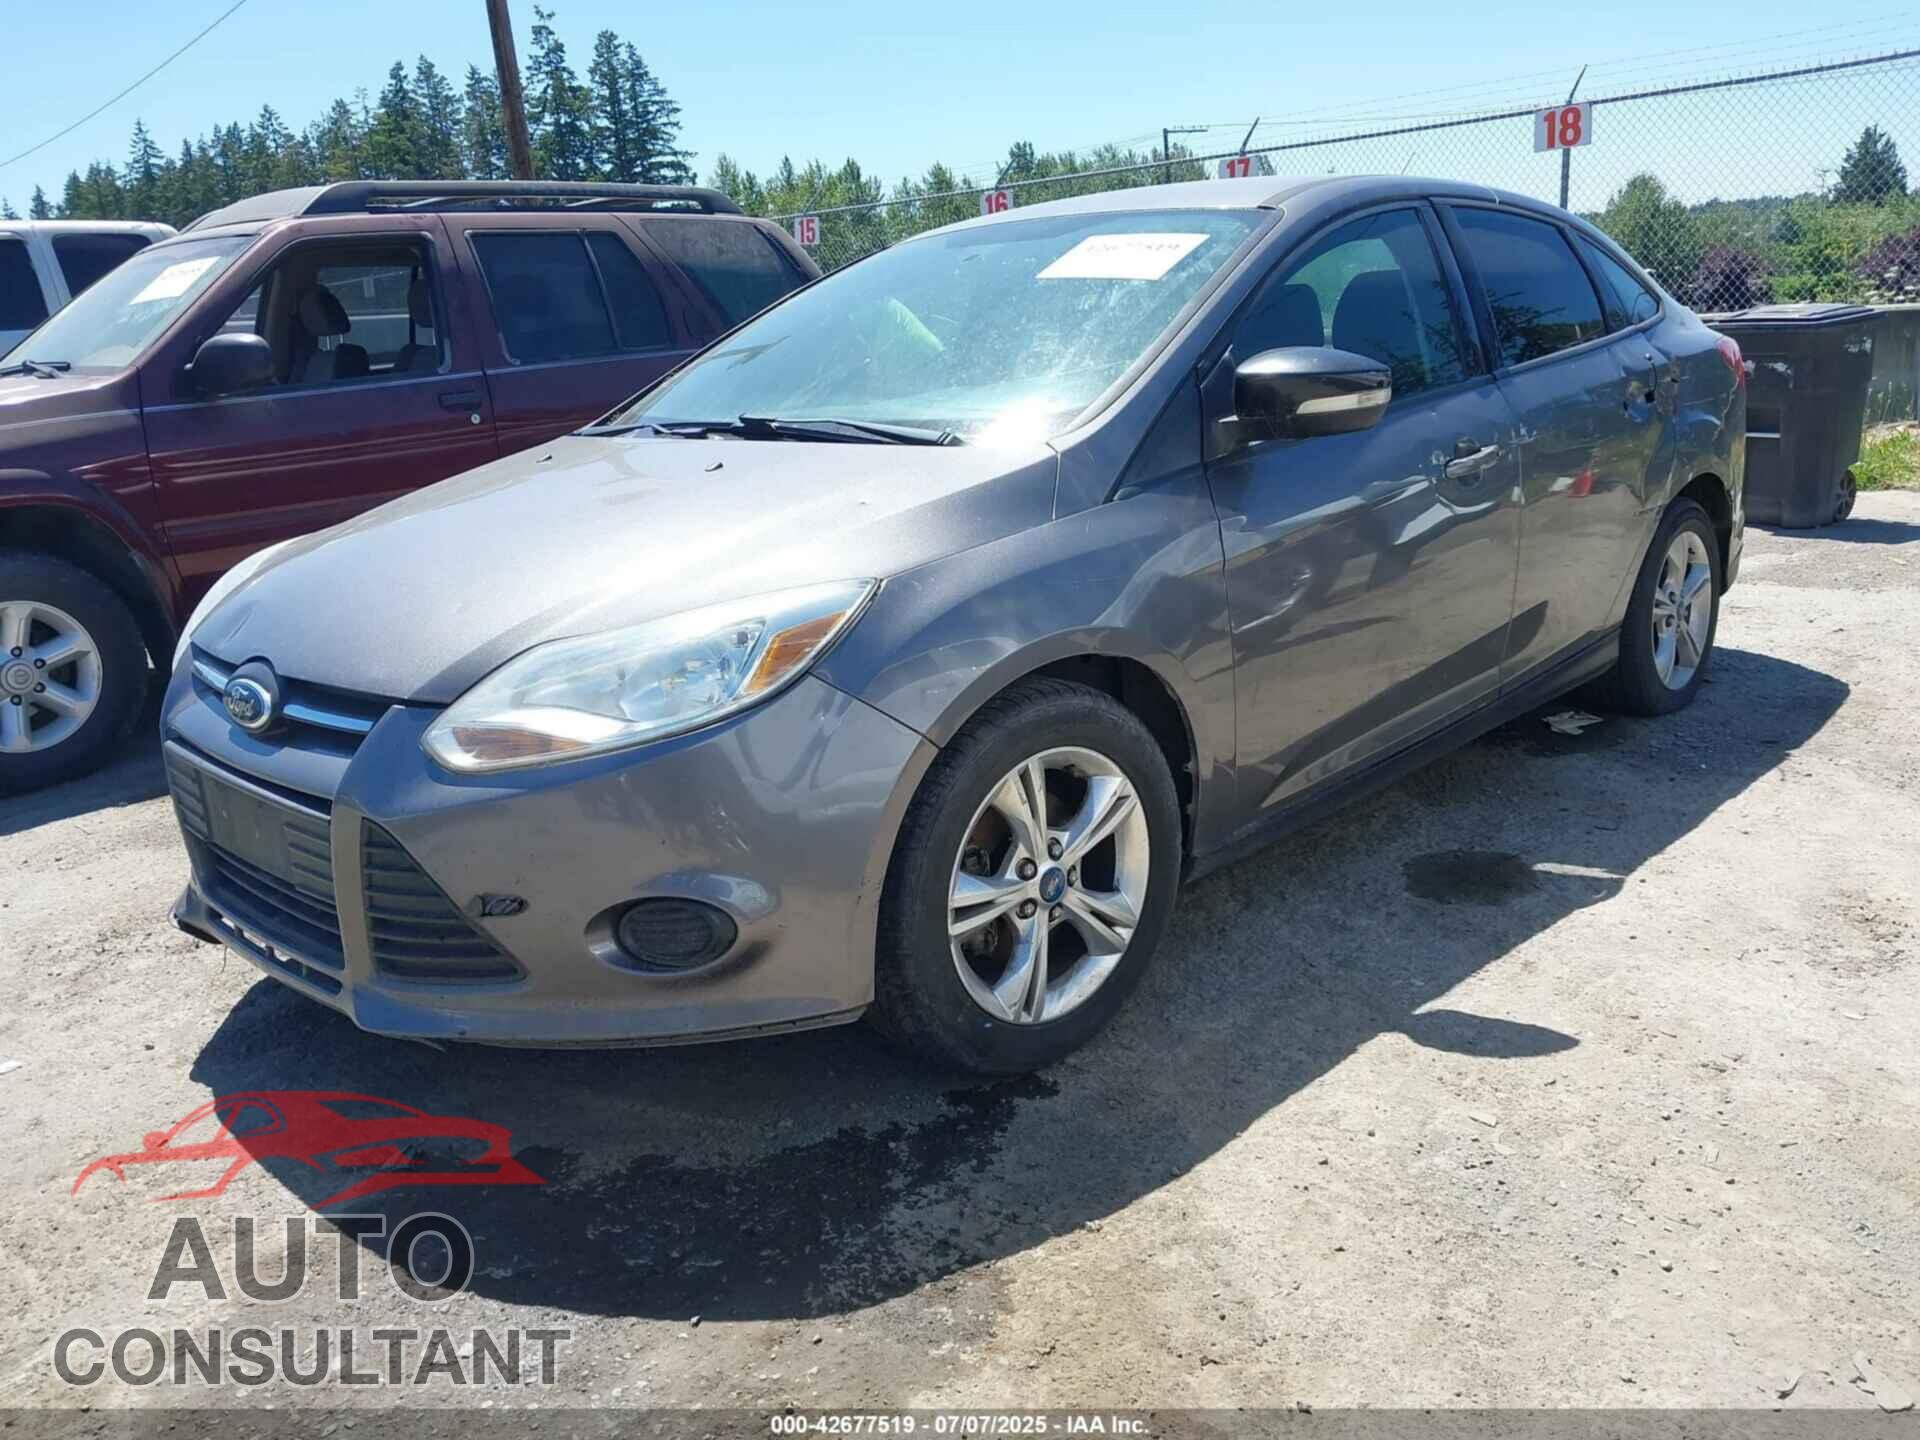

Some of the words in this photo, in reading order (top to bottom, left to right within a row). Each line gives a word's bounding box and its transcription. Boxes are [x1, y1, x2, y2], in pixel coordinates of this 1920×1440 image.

[1544, 107, 1582, 149] 18
[1226, 158, 1249, 177] 17
[985, 192, 1009, 215] 16
[800, 218, 816, 243] 15
